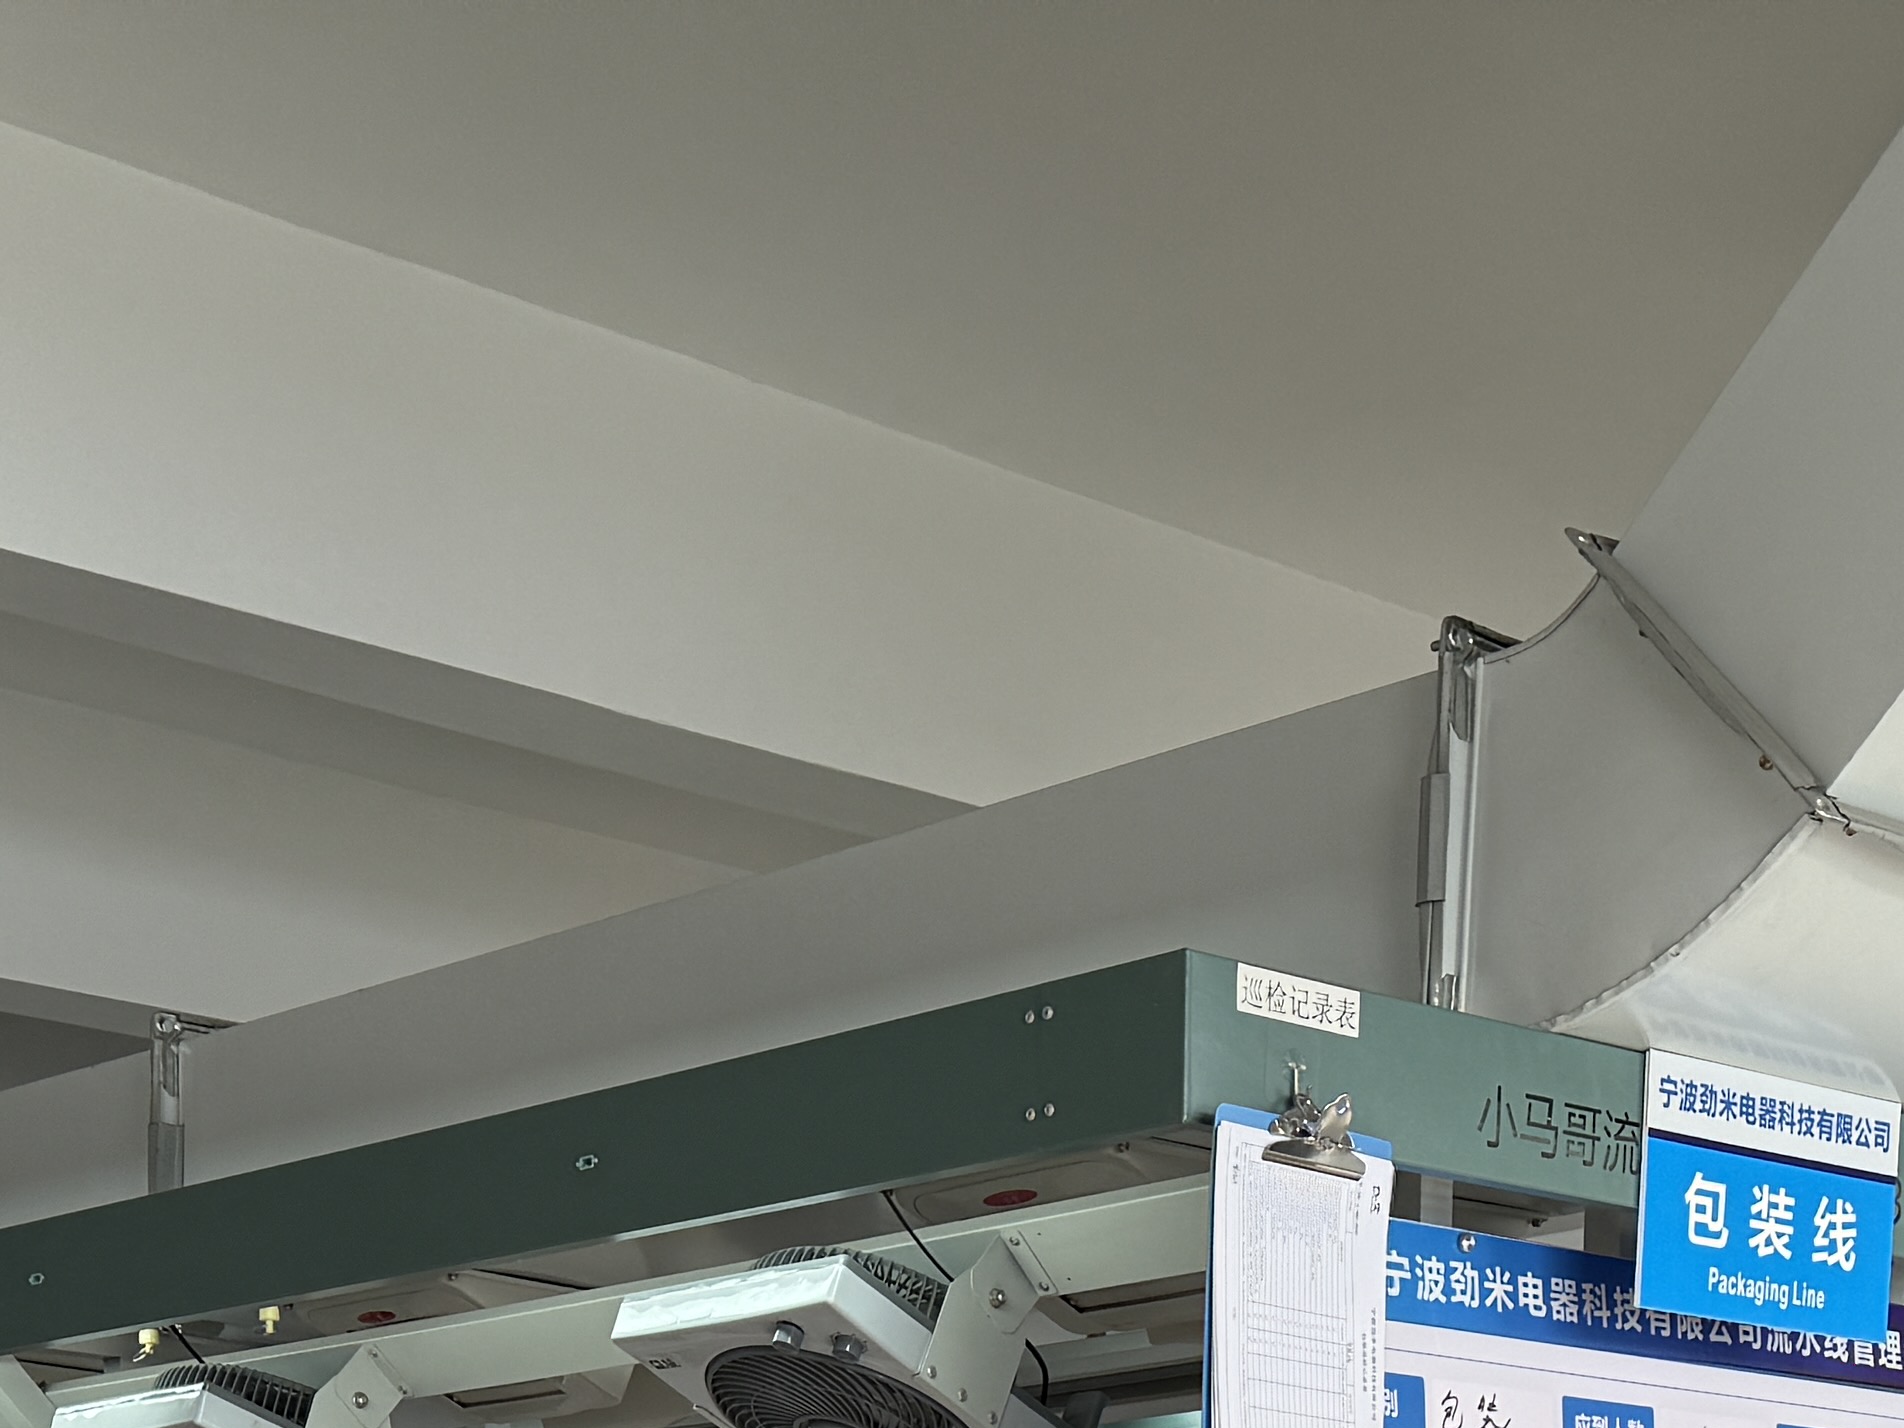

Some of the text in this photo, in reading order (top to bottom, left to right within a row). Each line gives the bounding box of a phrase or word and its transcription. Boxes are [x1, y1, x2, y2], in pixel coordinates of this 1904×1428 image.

[1241, 974, 1357, 1030] 巡检记录表
[1478, 1085, 1640, 1176] 小马哥流
[1659, 1076, 1890, 1153] 宁波劲米电器科技有限公司
[1684, 1172, 1858, 1272] 包装线
[1708, 1267, 1825, 1310] Packaging Line
